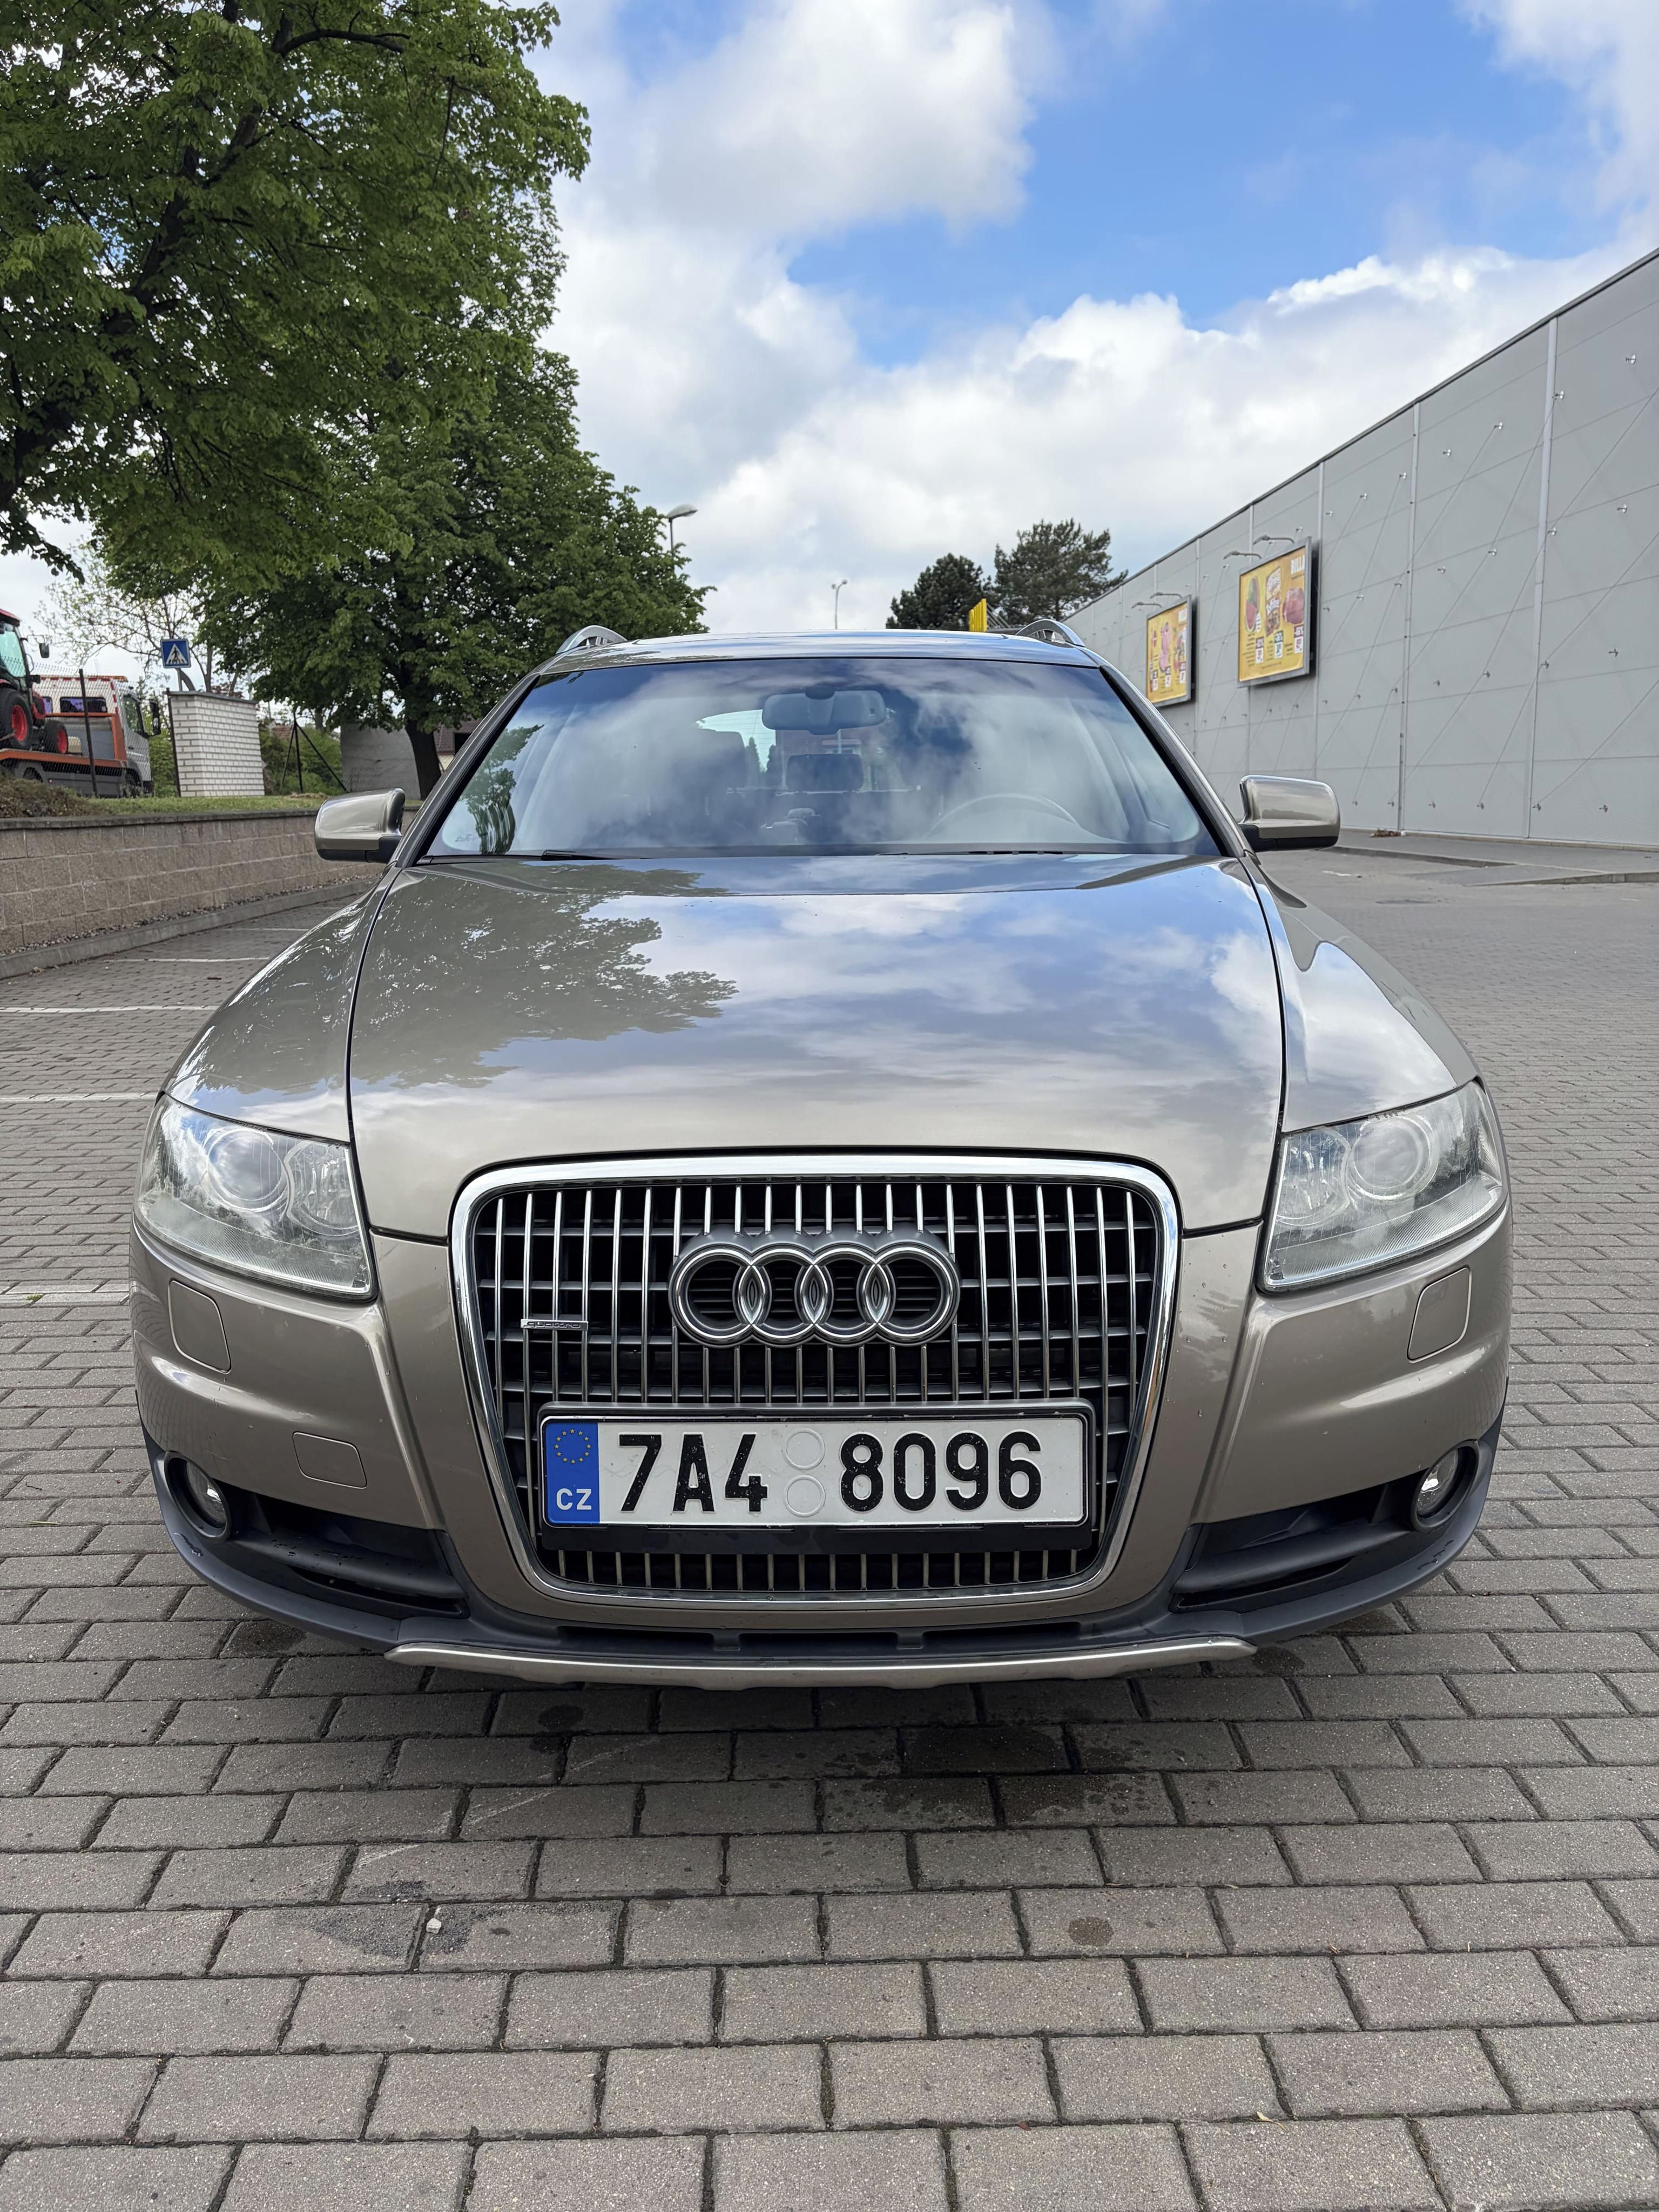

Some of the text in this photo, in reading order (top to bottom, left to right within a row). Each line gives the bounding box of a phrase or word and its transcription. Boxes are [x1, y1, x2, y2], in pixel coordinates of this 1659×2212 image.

[523, 1321, 582, 1329] quattro
[619, 1431, 1041, 1512] 7A4 8096
[556, 1488, 592, 1510] CZ
